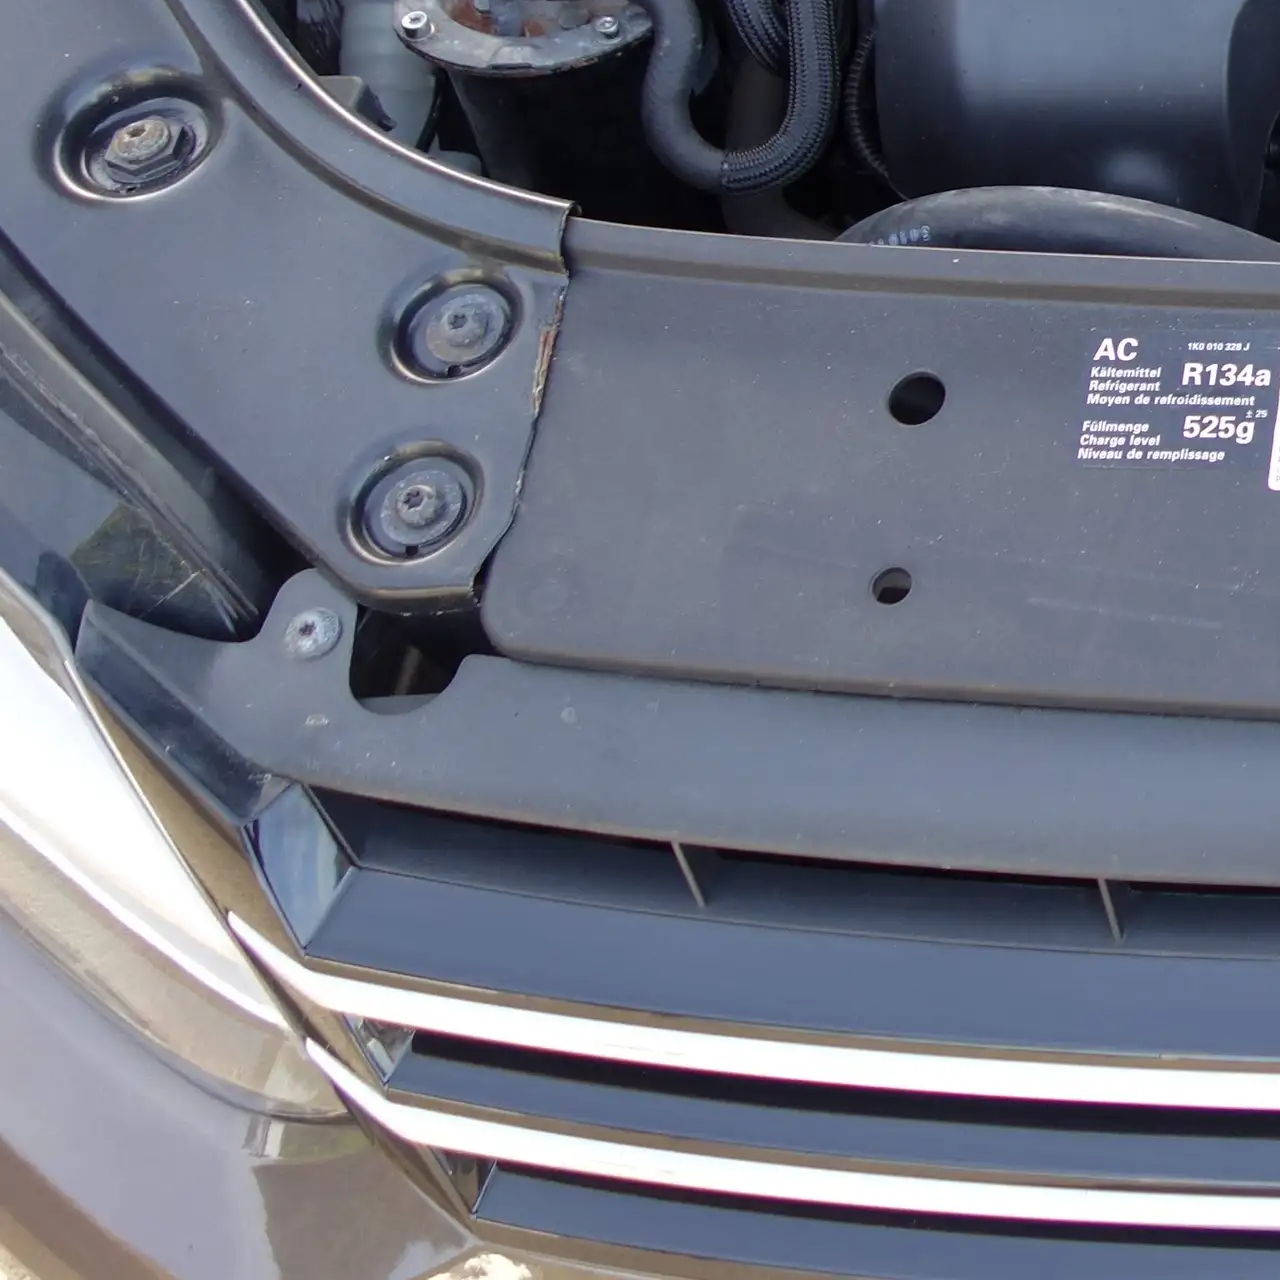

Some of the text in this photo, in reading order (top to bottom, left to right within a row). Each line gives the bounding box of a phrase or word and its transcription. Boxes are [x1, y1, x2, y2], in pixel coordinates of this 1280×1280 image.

[1094, 337, 1139, 361] AC
[1206, 342, 1224, 351] 010
[1225, 342, 1242, 351] 328
[1090, 366, 1162, 379] Kältemittel
[1182, 362, 1271, 386] R134a
[1089, 379, 1161, 393] Refrigerant
[1087, 393, 1256, 407] Moyen de refroidissement
[1082, 420, 1150, 434] Füllmenge
[1183, 415, 1256, 444] 525g
[1080, 433, 1161, 448] Charge level
[1077, 447, 1226, 463] Niveau de remplissage
